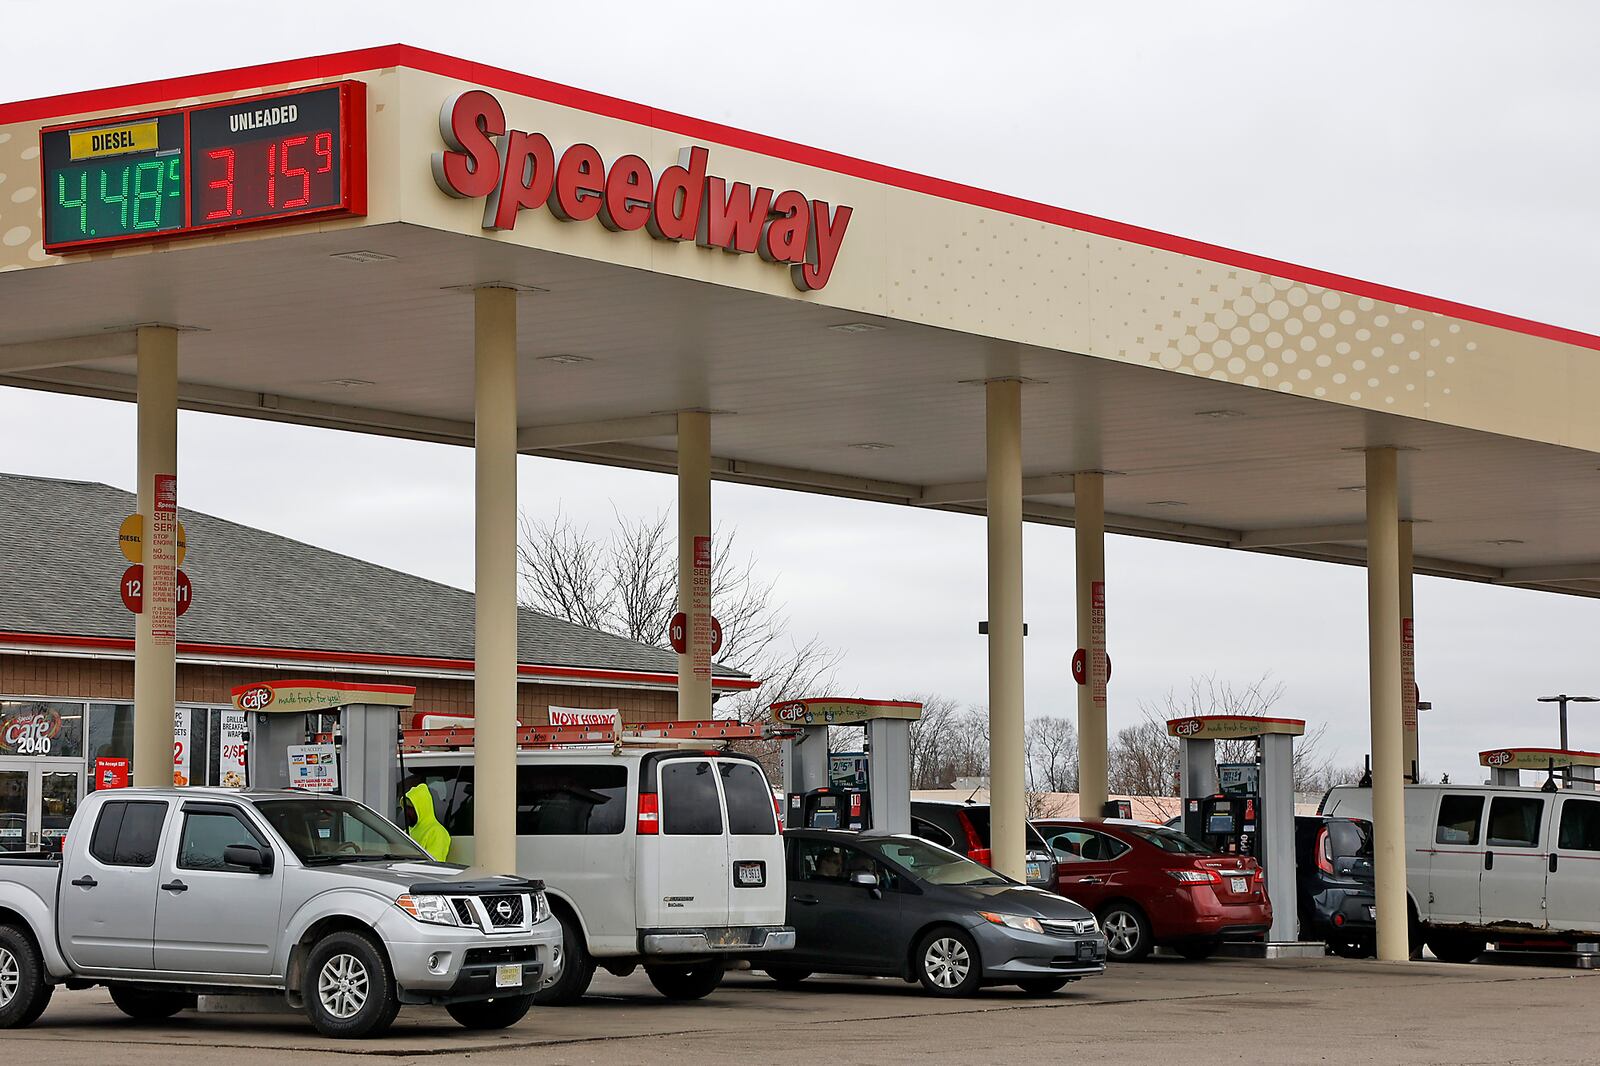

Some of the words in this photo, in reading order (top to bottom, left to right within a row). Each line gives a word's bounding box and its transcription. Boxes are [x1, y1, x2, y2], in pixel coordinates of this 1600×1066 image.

[229, 104, 298, 132] UNLEADED
[92, 130, 135, 152] DIESEL
[432, 90, 854, 292] Speedway
[119, 534, 141, 543] DIESEL
[126, 580, 141, 597] 12
[176, 584, 188, 602] 11
[672, 626, 682, 641] 10
[711, 631, 717, 644] 9
[1076, 660, 1082, 672] 8
[552, 711, 579, 725] NOW
[222, 723, 243, 731] BREAKFA
[17, 737, 51, 754] 2040
